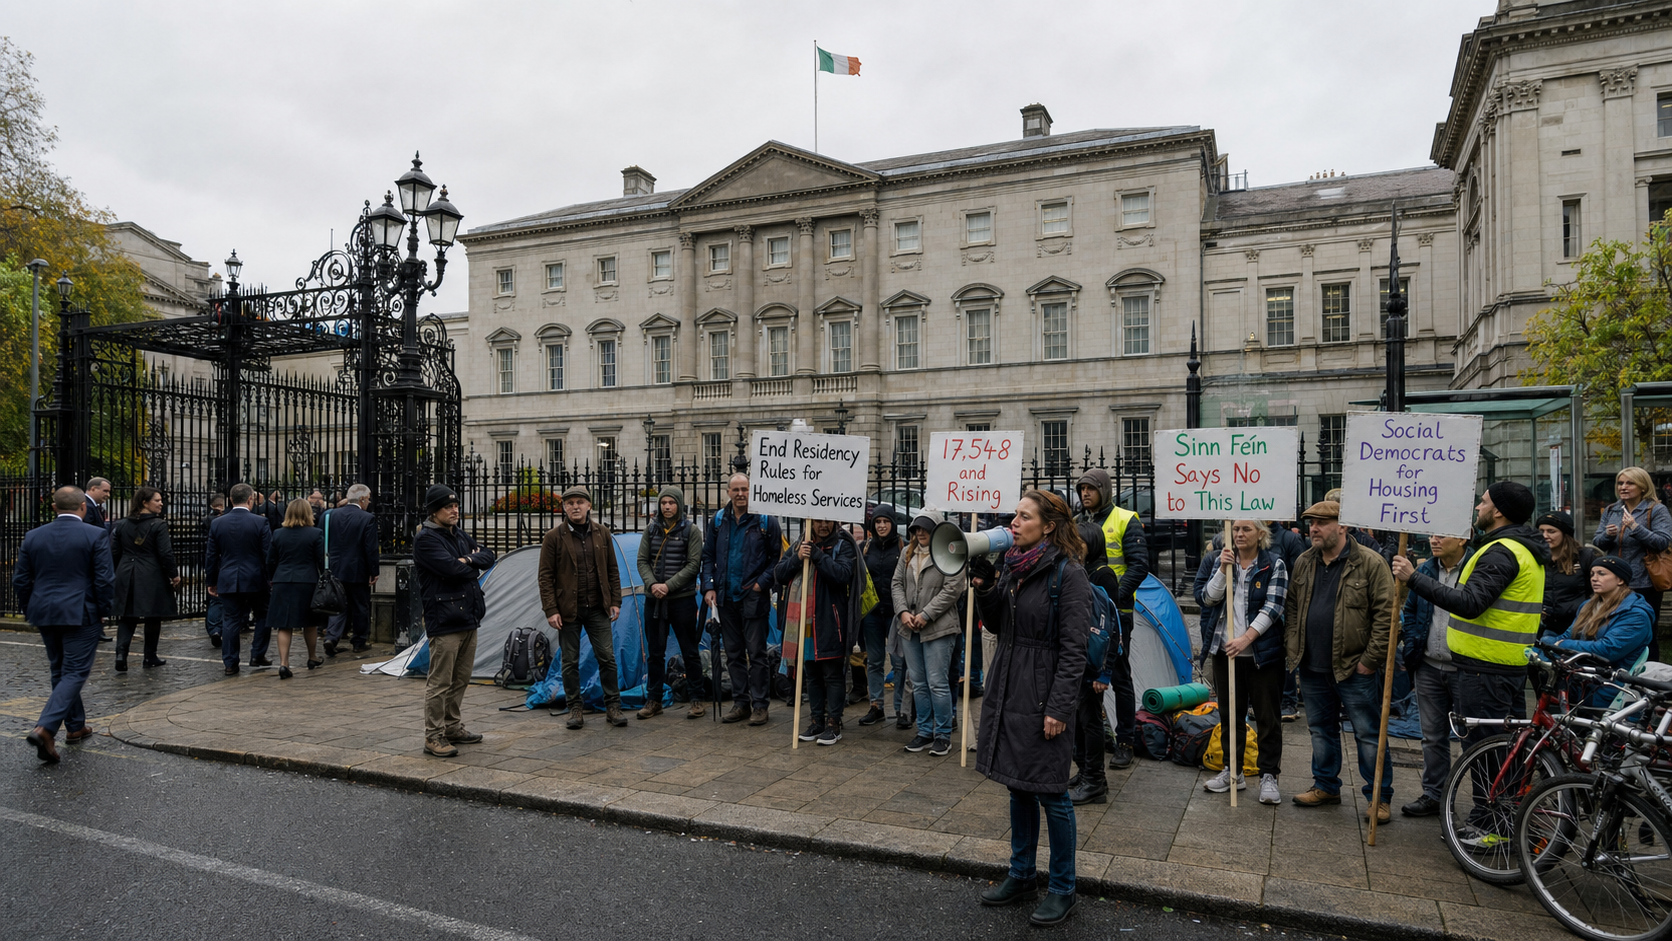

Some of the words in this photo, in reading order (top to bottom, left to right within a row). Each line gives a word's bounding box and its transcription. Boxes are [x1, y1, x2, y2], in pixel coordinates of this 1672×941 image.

[1381, 418, 1444, 440] Social
[759, 437, 787, 458] End
[793, 438, 860, 468] Residency
[943, 438, 1012, 462] 17,548
[1174, 432, 1221, 457] Sinn
[1359, 441, 1466, 463] Democrats
[759, 460, 796, 480] Rules
[802, 464, 823, 480] for
[959, 464, 987, 480] and
[1174, 462, 1221, 489] Says
[1233, 462, 1261, 484] No
[1396, 463, 1424, 479] for
[753, 484, 807, 506] Homeless
[810, 488, 863, 509] Services
[947, 481, 1001, 510] Rising
[1167, 491, 1186, 512] to
[1193, 490, 1233, 511] This
[1240, 491, 1275, 511] Law
[1368, 477, 1438, 504] Housing
[1380, 503, 1432, 524] First
